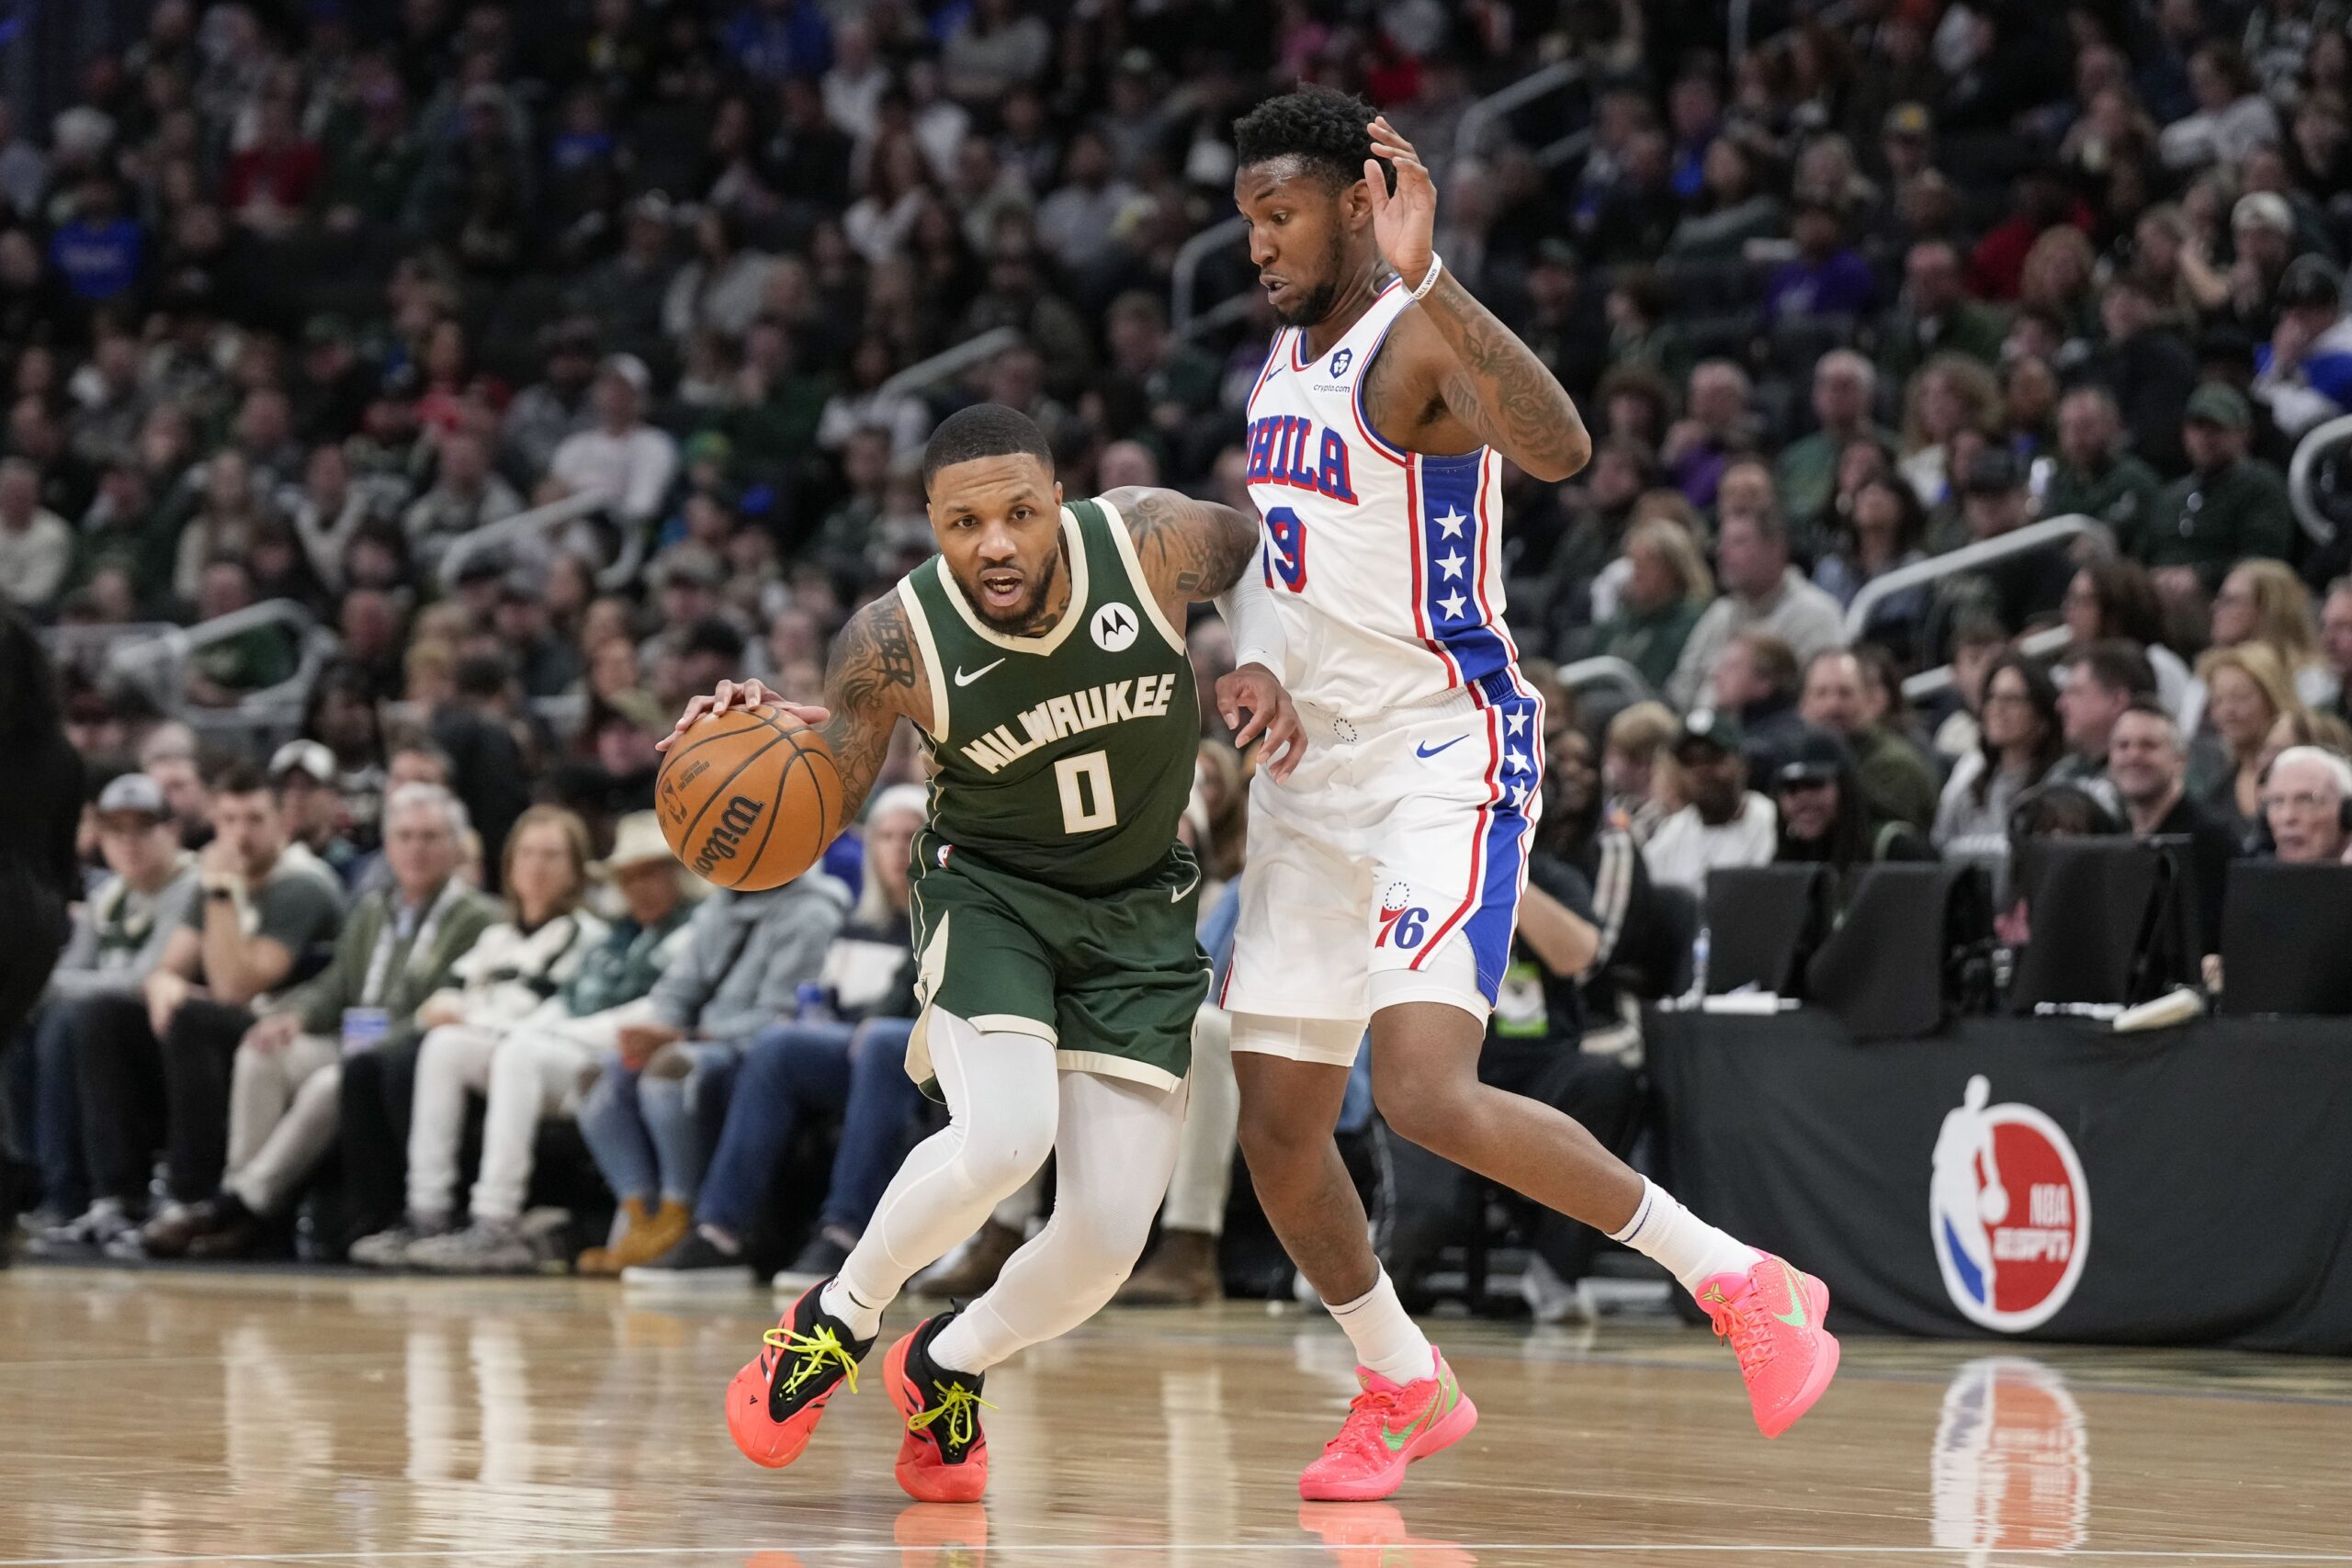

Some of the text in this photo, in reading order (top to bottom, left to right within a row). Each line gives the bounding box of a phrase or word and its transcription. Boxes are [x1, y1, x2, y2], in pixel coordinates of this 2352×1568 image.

[1426, 268, 1437, 285] WINS
[1313, 384, 1351, 393] crypto.com
[960, 673, 1176, 774] MILWAUKEE
[1054, 750, 1118, 834] 0
[691, 793, 766, 878] Wilson
[1374, 905, 1429, 949] 76
[2029, 1182, 2072, 1226] NBA
[1993, 1227, 2072, 1262] ESPN
